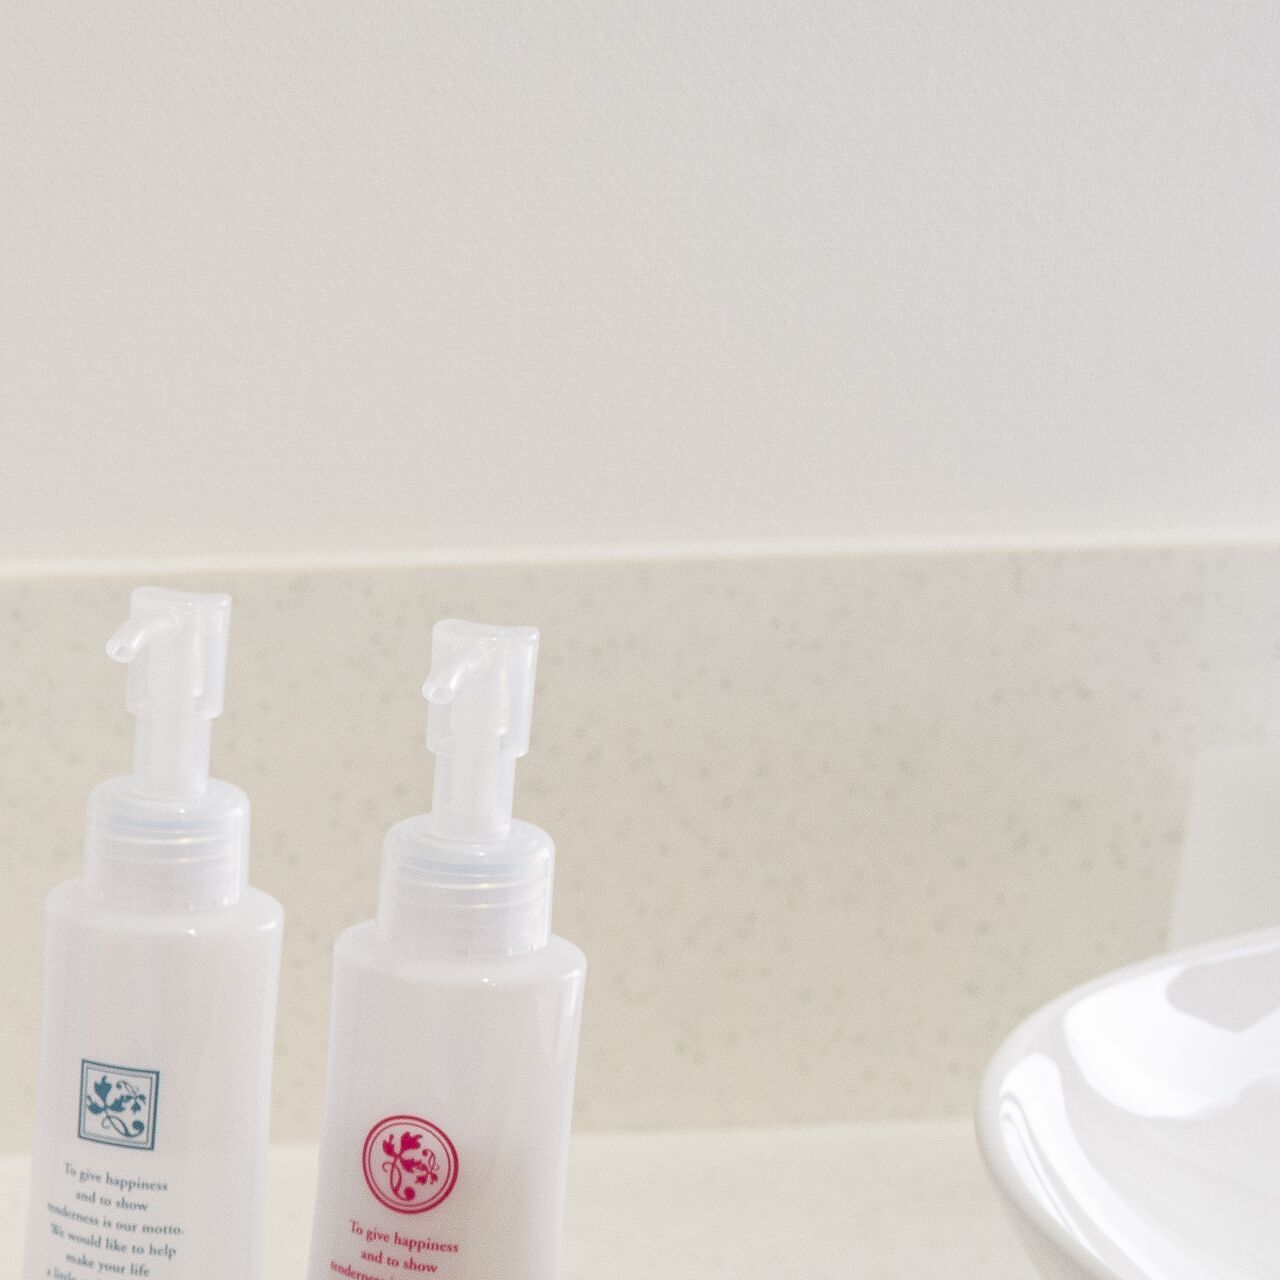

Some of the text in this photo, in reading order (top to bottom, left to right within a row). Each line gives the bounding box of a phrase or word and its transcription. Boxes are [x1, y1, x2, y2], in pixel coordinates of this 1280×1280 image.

[64, 1161, 168, 1192] To give happiness
[75, 1191, 148, 1211] and to show
[103, 1218, 112, 1229] is
[116, 1221, 137, 1234] our
[142, 1225, 184, 1236] motto.
[350, 1219, 459, 1254] To give happiness
[50, 1223, 177, 1261] We would like to help
[66, 1253, 150, 1277] make your life
[361, 1250, 438, 1273] and to show
